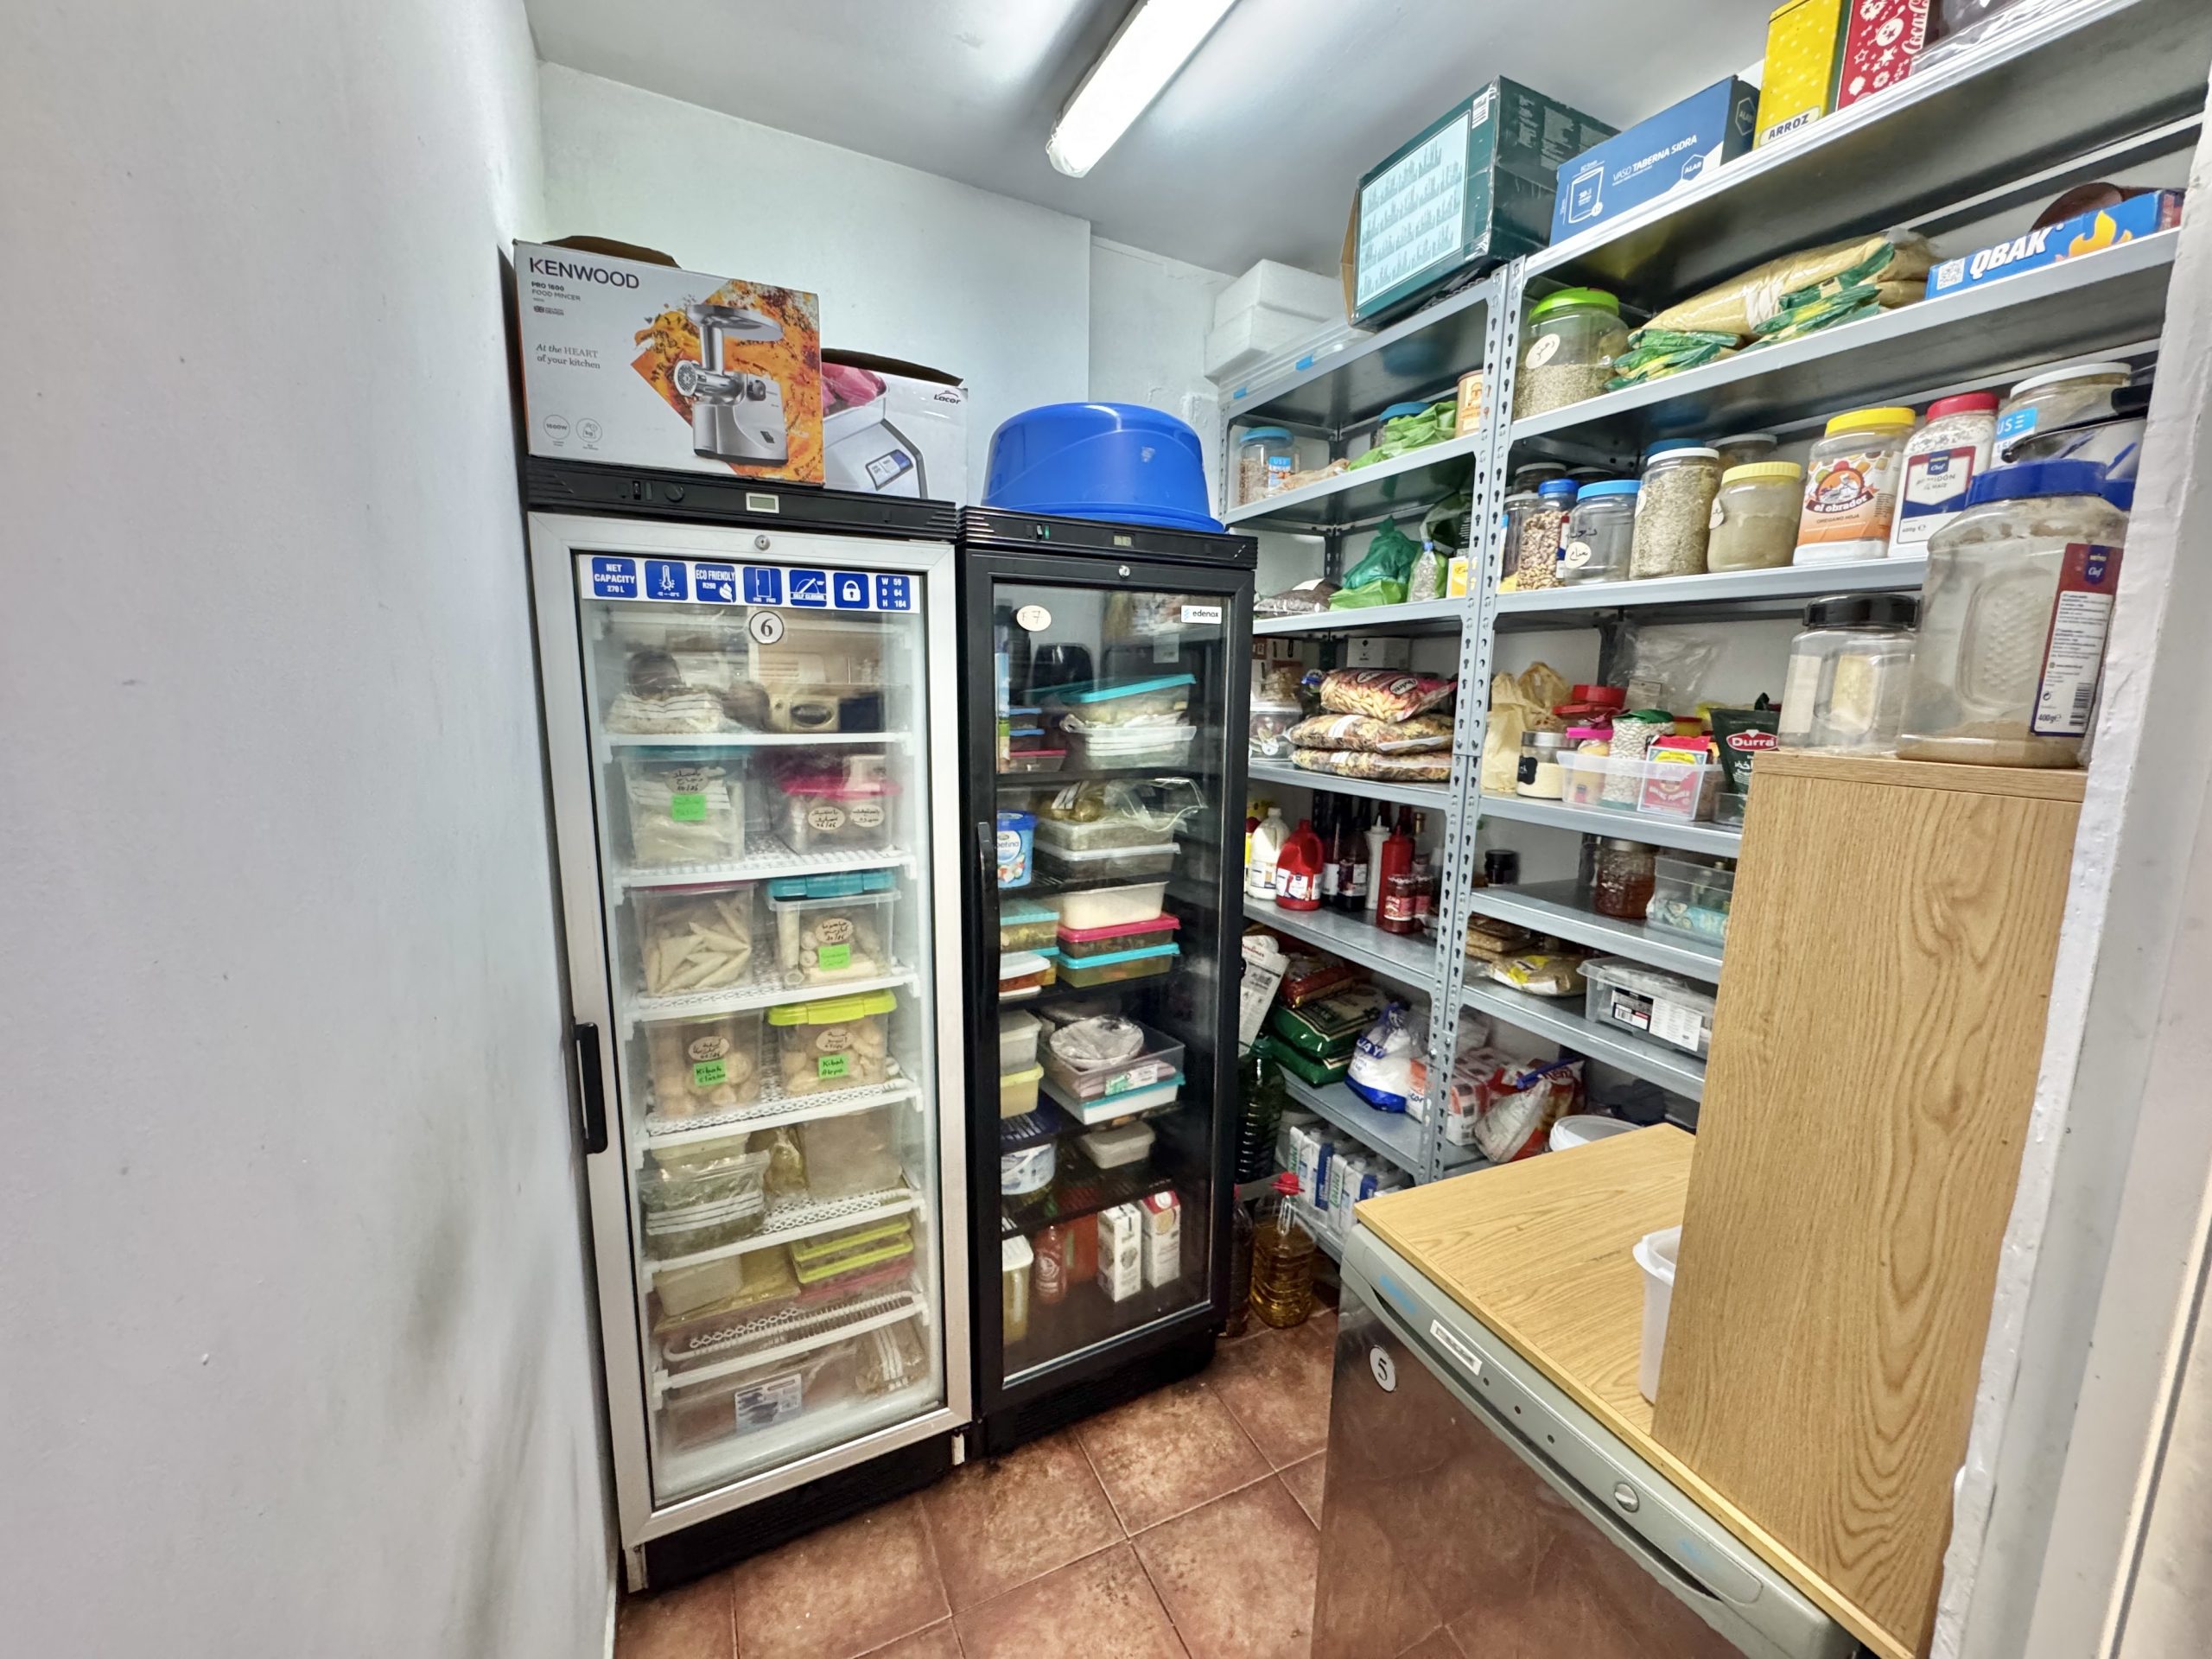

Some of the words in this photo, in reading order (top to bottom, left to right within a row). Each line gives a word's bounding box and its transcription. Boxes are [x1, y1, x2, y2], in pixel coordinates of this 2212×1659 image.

[1768, 113, 1809, 140] ARROZ
[1612, 166, 1632, 181] VASO
[1632, 148, 1670, 172] TABERNA
[1670, 134, 1698, 155] SIDRA
[1968, 226, 2053, 280] QBAK
[530, 257, 639, 289] KENWOOD
[531, 289, 553, 297] FOOD
[554, 292, 581, 302] MINCER
[536, 343, 547, 352] At
[548, 345, 563, 354] the
[564, 346, 599, 358] HEART
[537, 353, 546, 363] of
[547, 355, 568, 365] your
[569, 358, 601, 369] kitchen
[933, 394, 961, 404] Lacor
[1825, 495, 1867, 512] obrador
[606, 563, 622, 572] NET
[696, 569, 707, 580] ECO
[709, 570, 734, 582] FRIENDLY
[594, 574, 635, 584] CAPACITY
[1192, 609, 1219, 618] edenox
[760, 618, 773, 637] 6
[1377, 1357, 1387, 1381] 5
